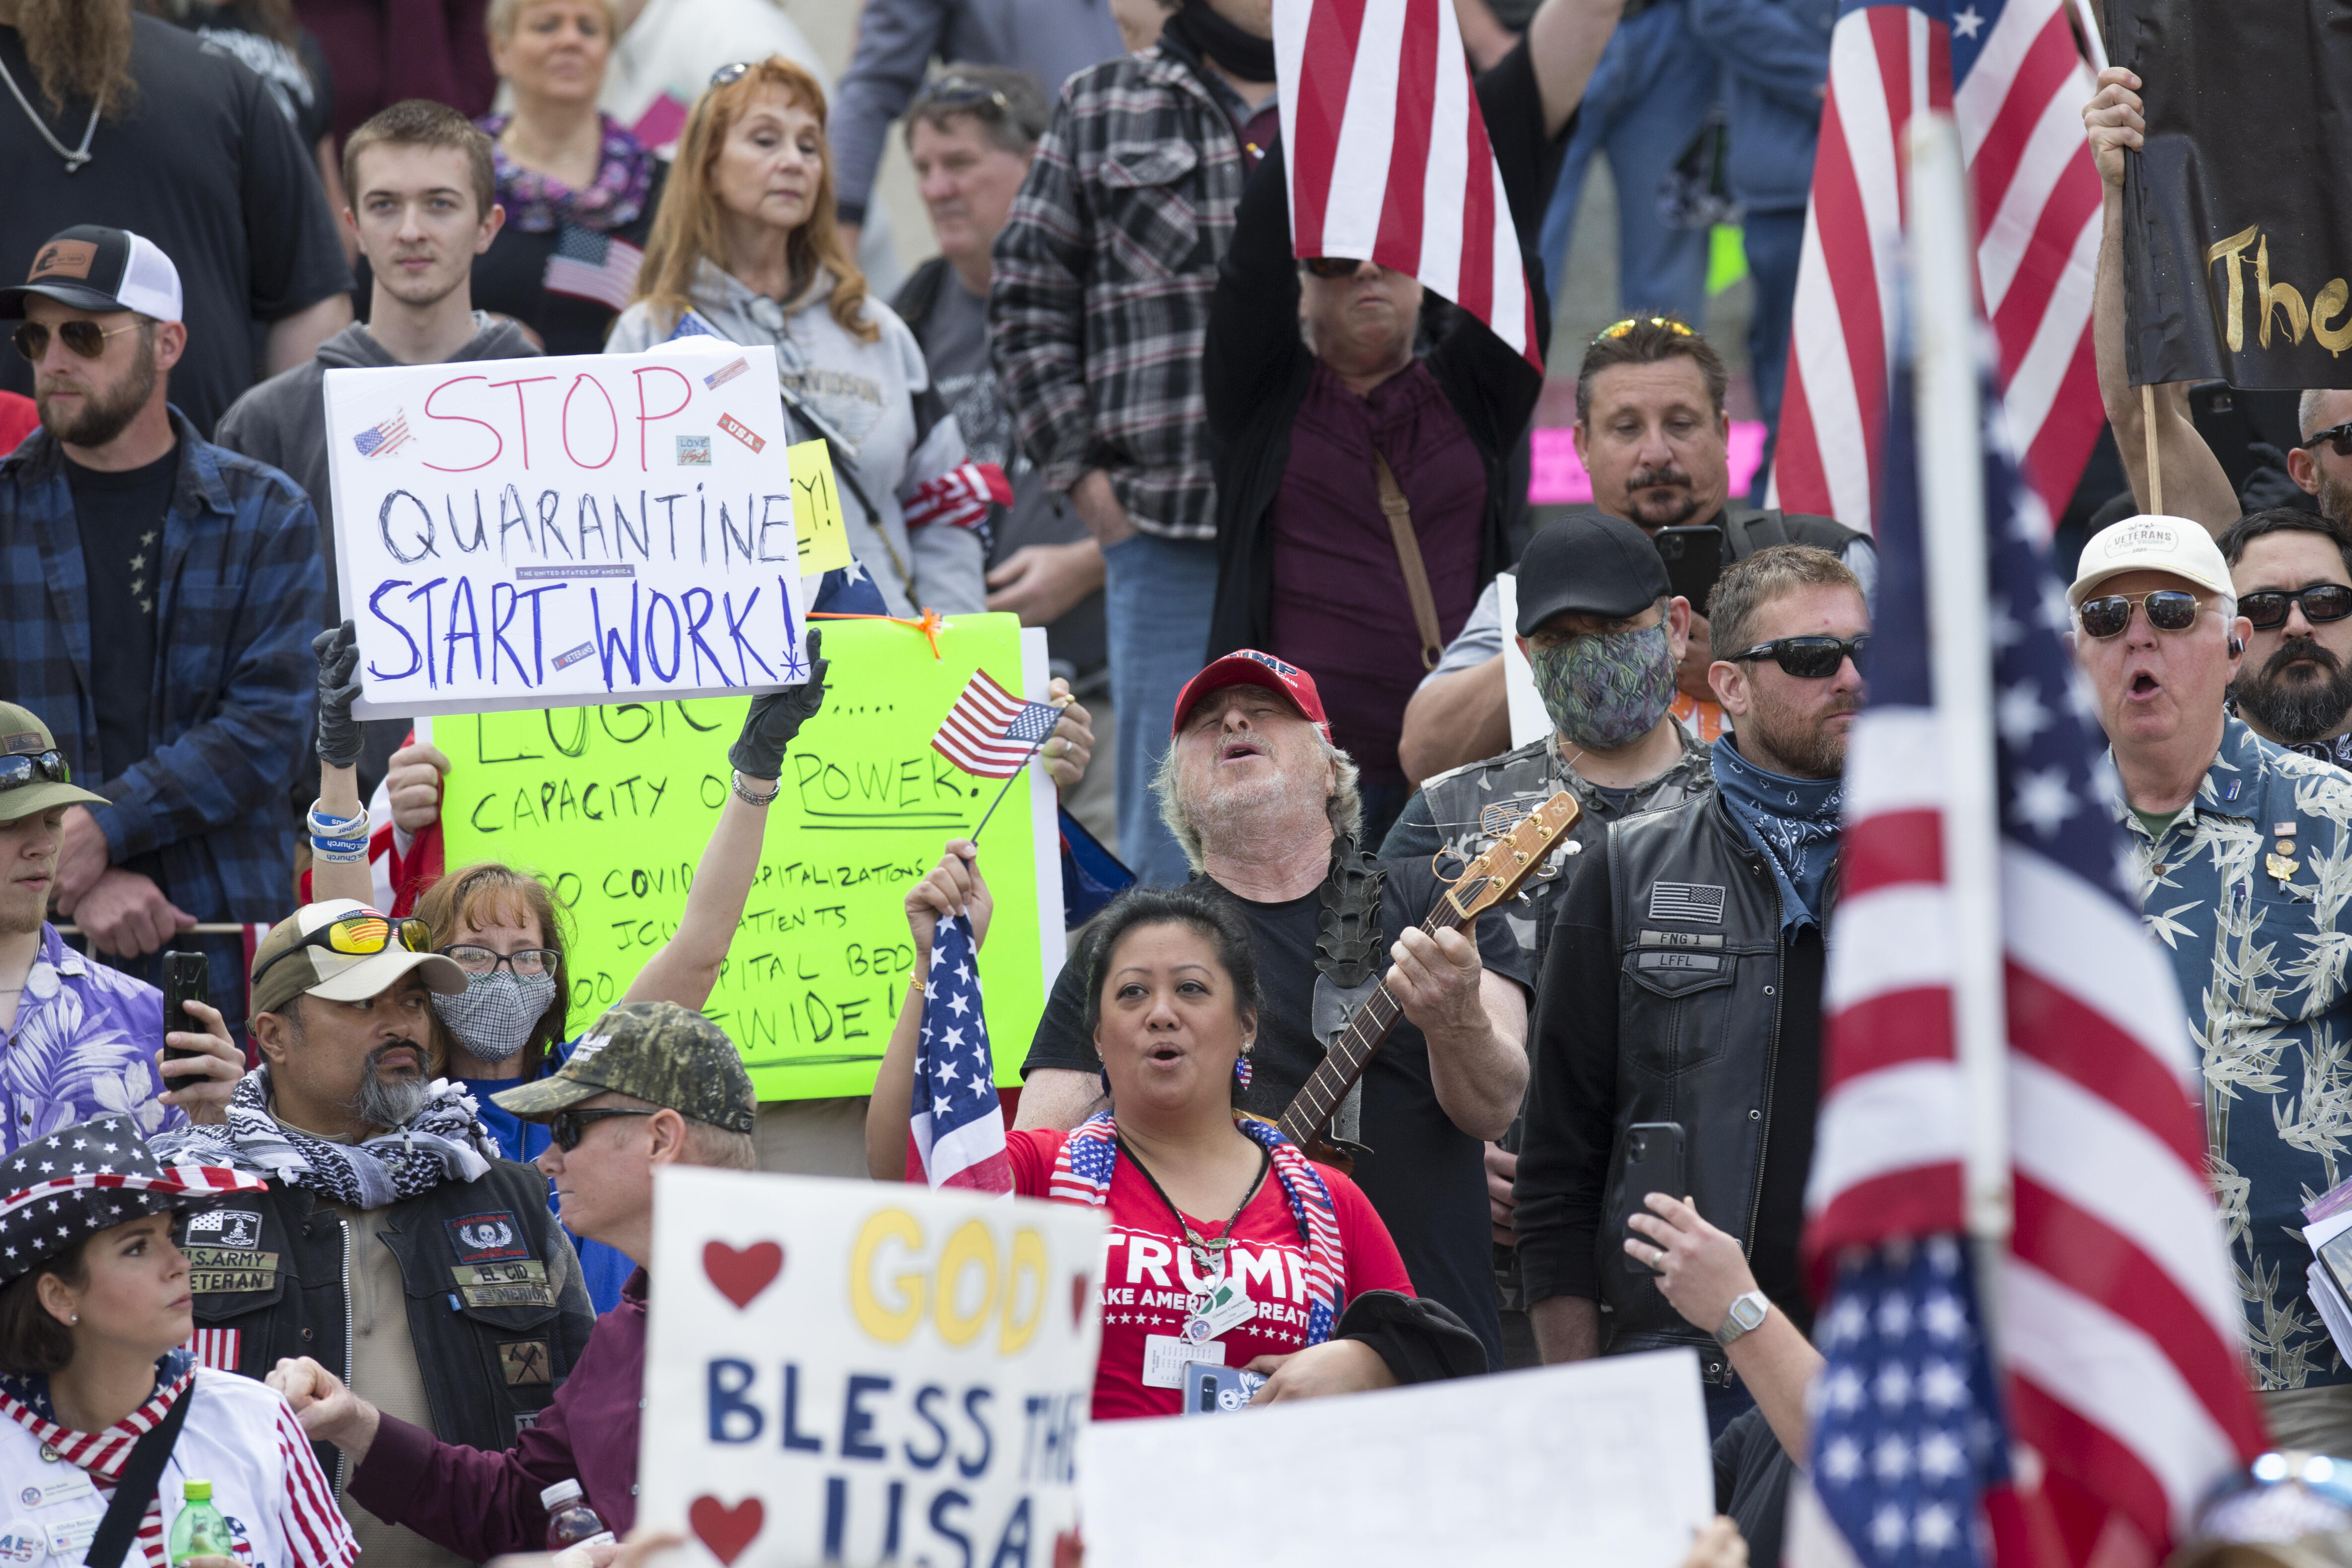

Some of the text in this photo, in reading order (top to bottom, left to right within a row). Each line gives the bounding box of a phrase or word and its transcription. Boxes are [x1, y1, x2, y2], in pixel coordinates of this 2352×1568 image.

[2207, 223, 2352, 358] The
[422, 366, 692, 472] STOP
[680, 439, 706, 447] LOVE
[728, 421, 754, 446] USA
[681, 449, 709, 463] USA
[790, 469, 831, 530] Y!
[379, 483, 789, 571] QUARANTINE
[2114, 530, 2171, 546] VETERANS
[367, 576, 567, 690] START
[563, 644, 594, 664] VETERANS
[471, 775, 667, 833] CAPACITY
[338, 820, 360, 834] Gather
[736, 906, 847, 933] ATIENTS
[1660, 933, 1701, 945] FNG 1
[846, 943, 914, 977] BED
[1660, 954, 1693, 967] LFFL
[453, 1215, 496, 1227] COALITION
[190, 1273, 264, 1290] ETERAN
[478, 1264, 528, 1282] EL CID
[851, 1208, 1047, 1355] GOD
[1093, 1288, 1135, 1306] AKE
[708, 1357, 1085, 1486] BLESS THE
